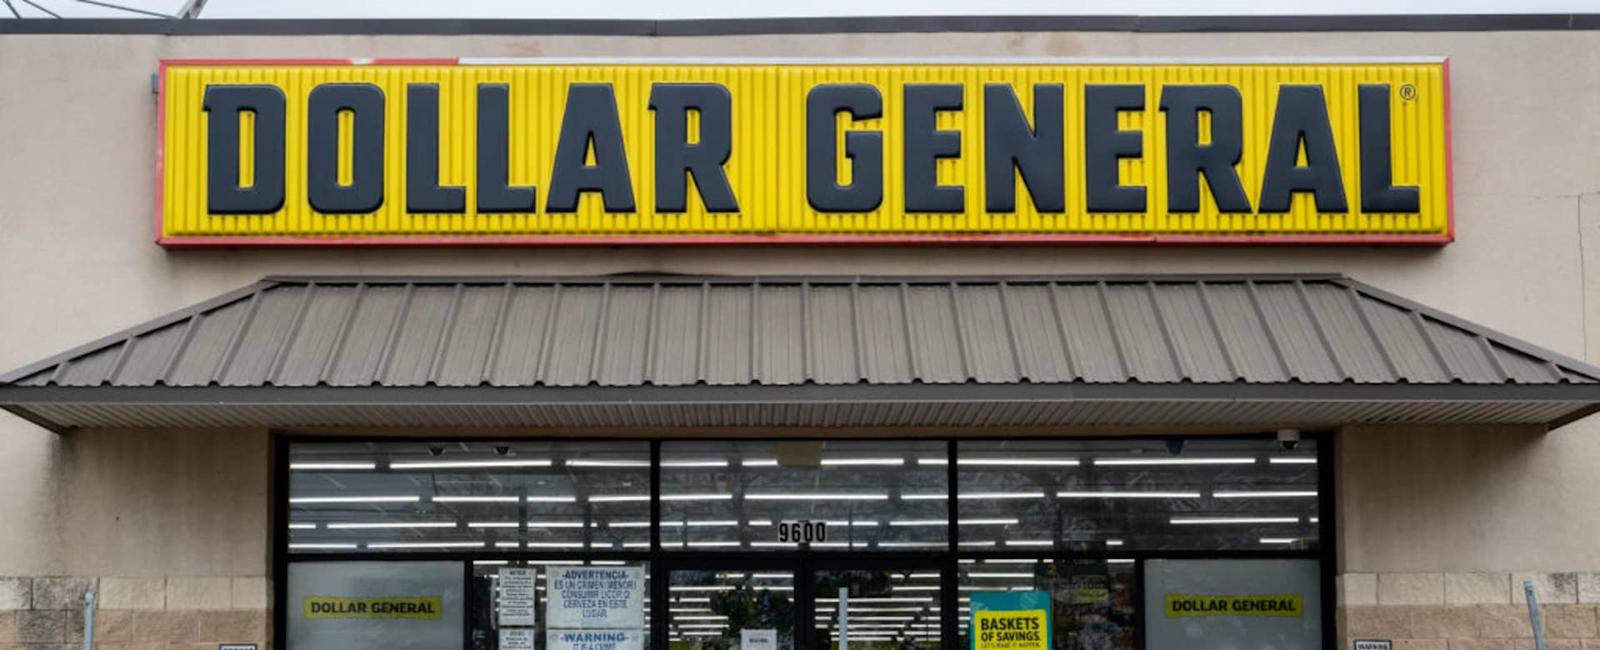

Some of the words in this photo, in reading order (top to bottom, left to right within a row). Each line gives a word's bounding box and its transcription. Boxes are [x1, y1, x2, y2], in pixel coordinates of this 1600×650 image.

[202, 82, 741, 215] DOLLAR
[806, 83, 1421, 213] GENERAL
[779, 522, 826, 543] 9600
[311, 602, 367, 613] DOLLAR
[371, 602, 436, 613] GENERAL
[1172, 600, 1228, 611] DOLLAR
[1232, 600, 1297, 611] GENERAL
[980, 617, 1040, 630] BASKETS
[981, 632, 994, 641] OF
[996, 631, 1040, 641] SAVINGS
